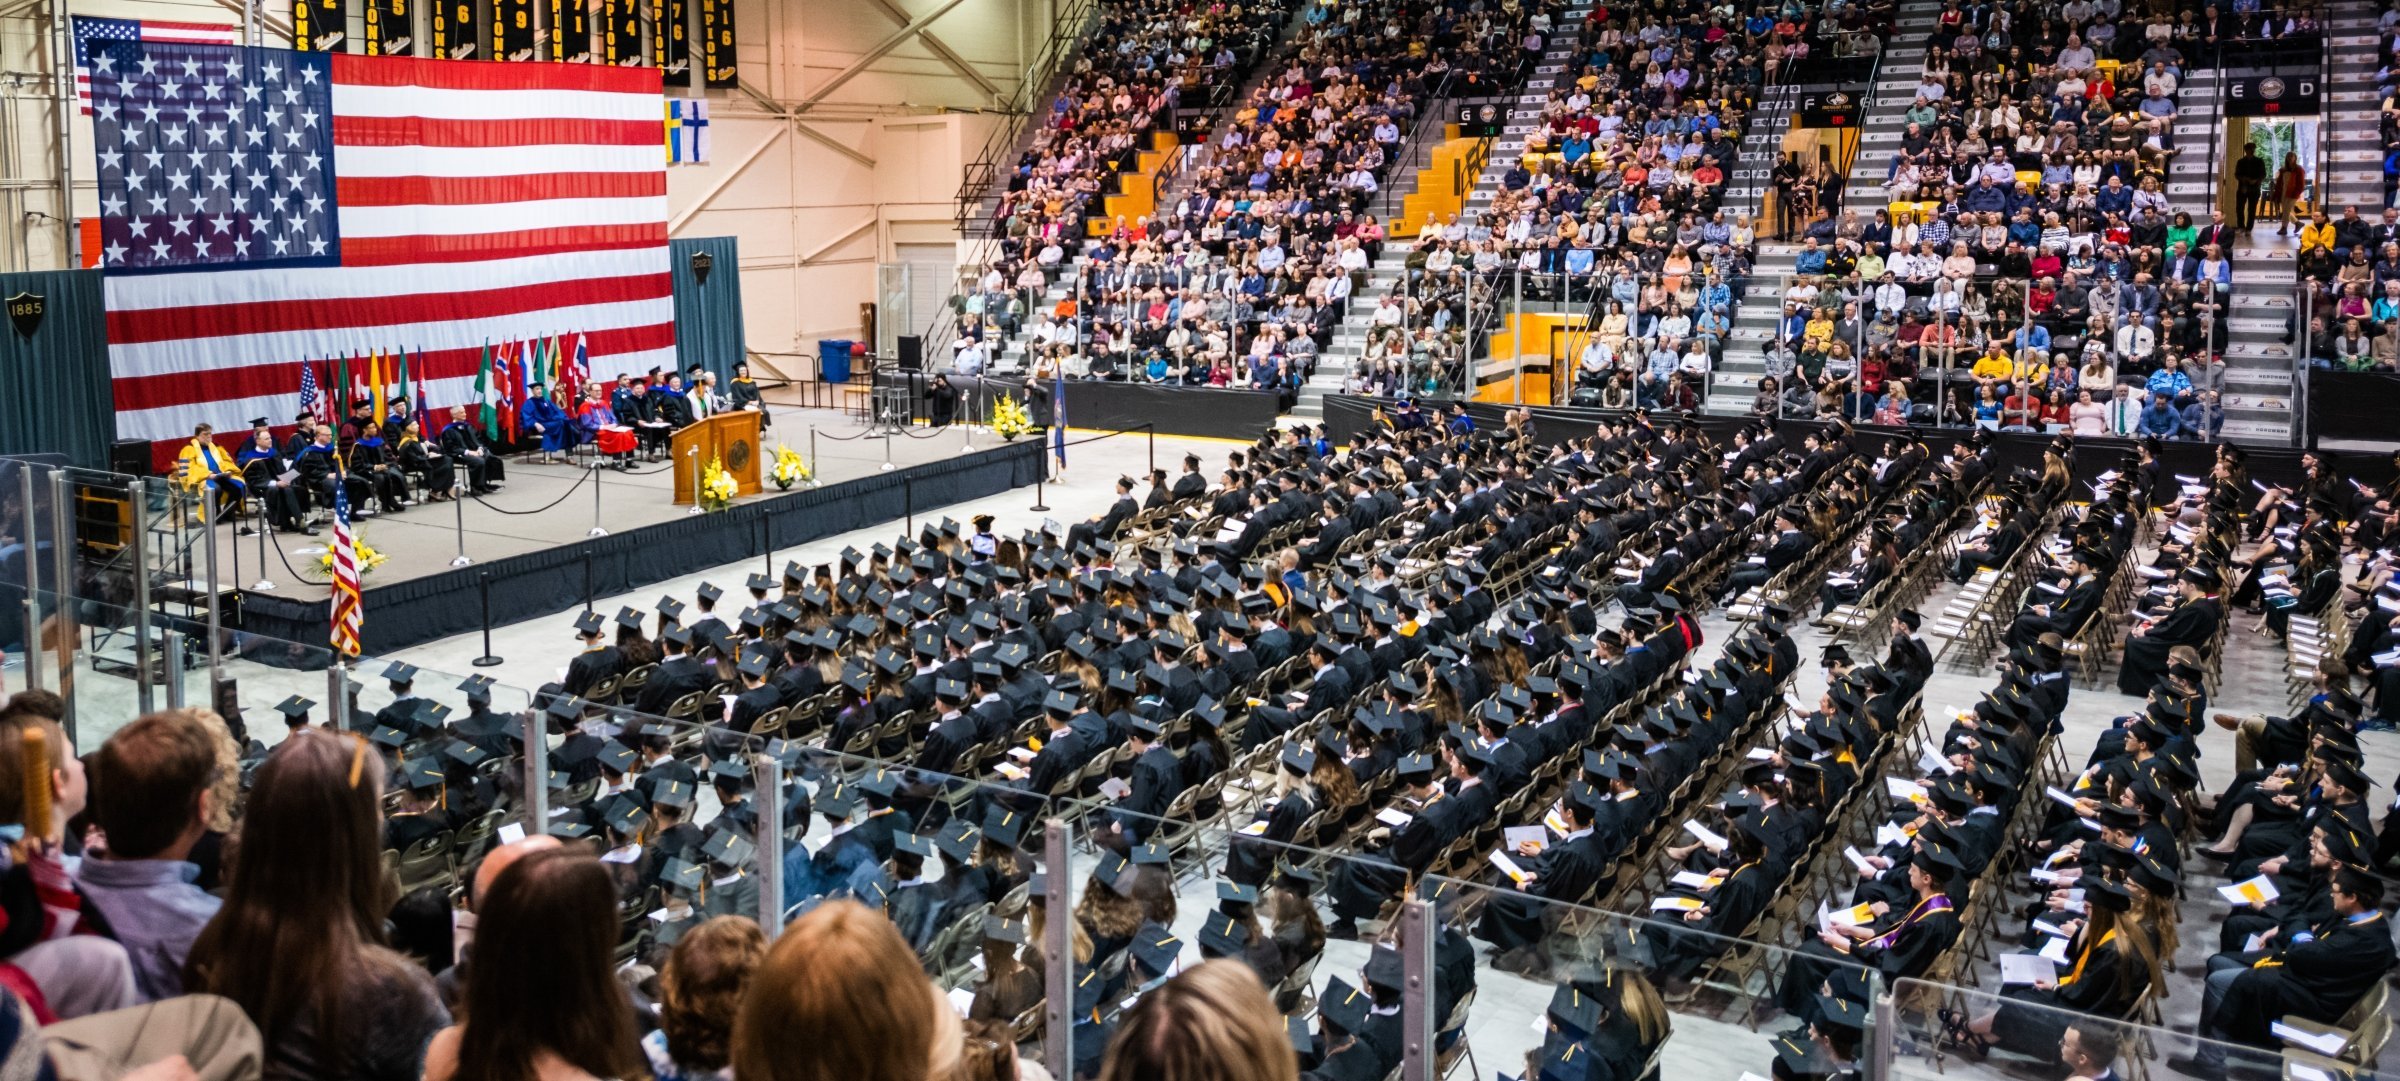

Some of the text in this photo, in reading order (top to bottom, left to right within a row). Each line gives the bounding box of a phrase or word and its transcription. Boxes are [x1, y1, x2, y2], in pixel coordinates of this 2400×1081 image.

[457, 5, 470, 23] 6
[672, 3, 683, 40] 76
[2231, 84, 2244, 97] E
[2300, 82, 2314, 96] D
[1804, 98, 1815, 110] F
[1461, 110, 1471, 121] G
[1179, 120, 1187, 131] H
[12, 302, 42, 317] 1885
